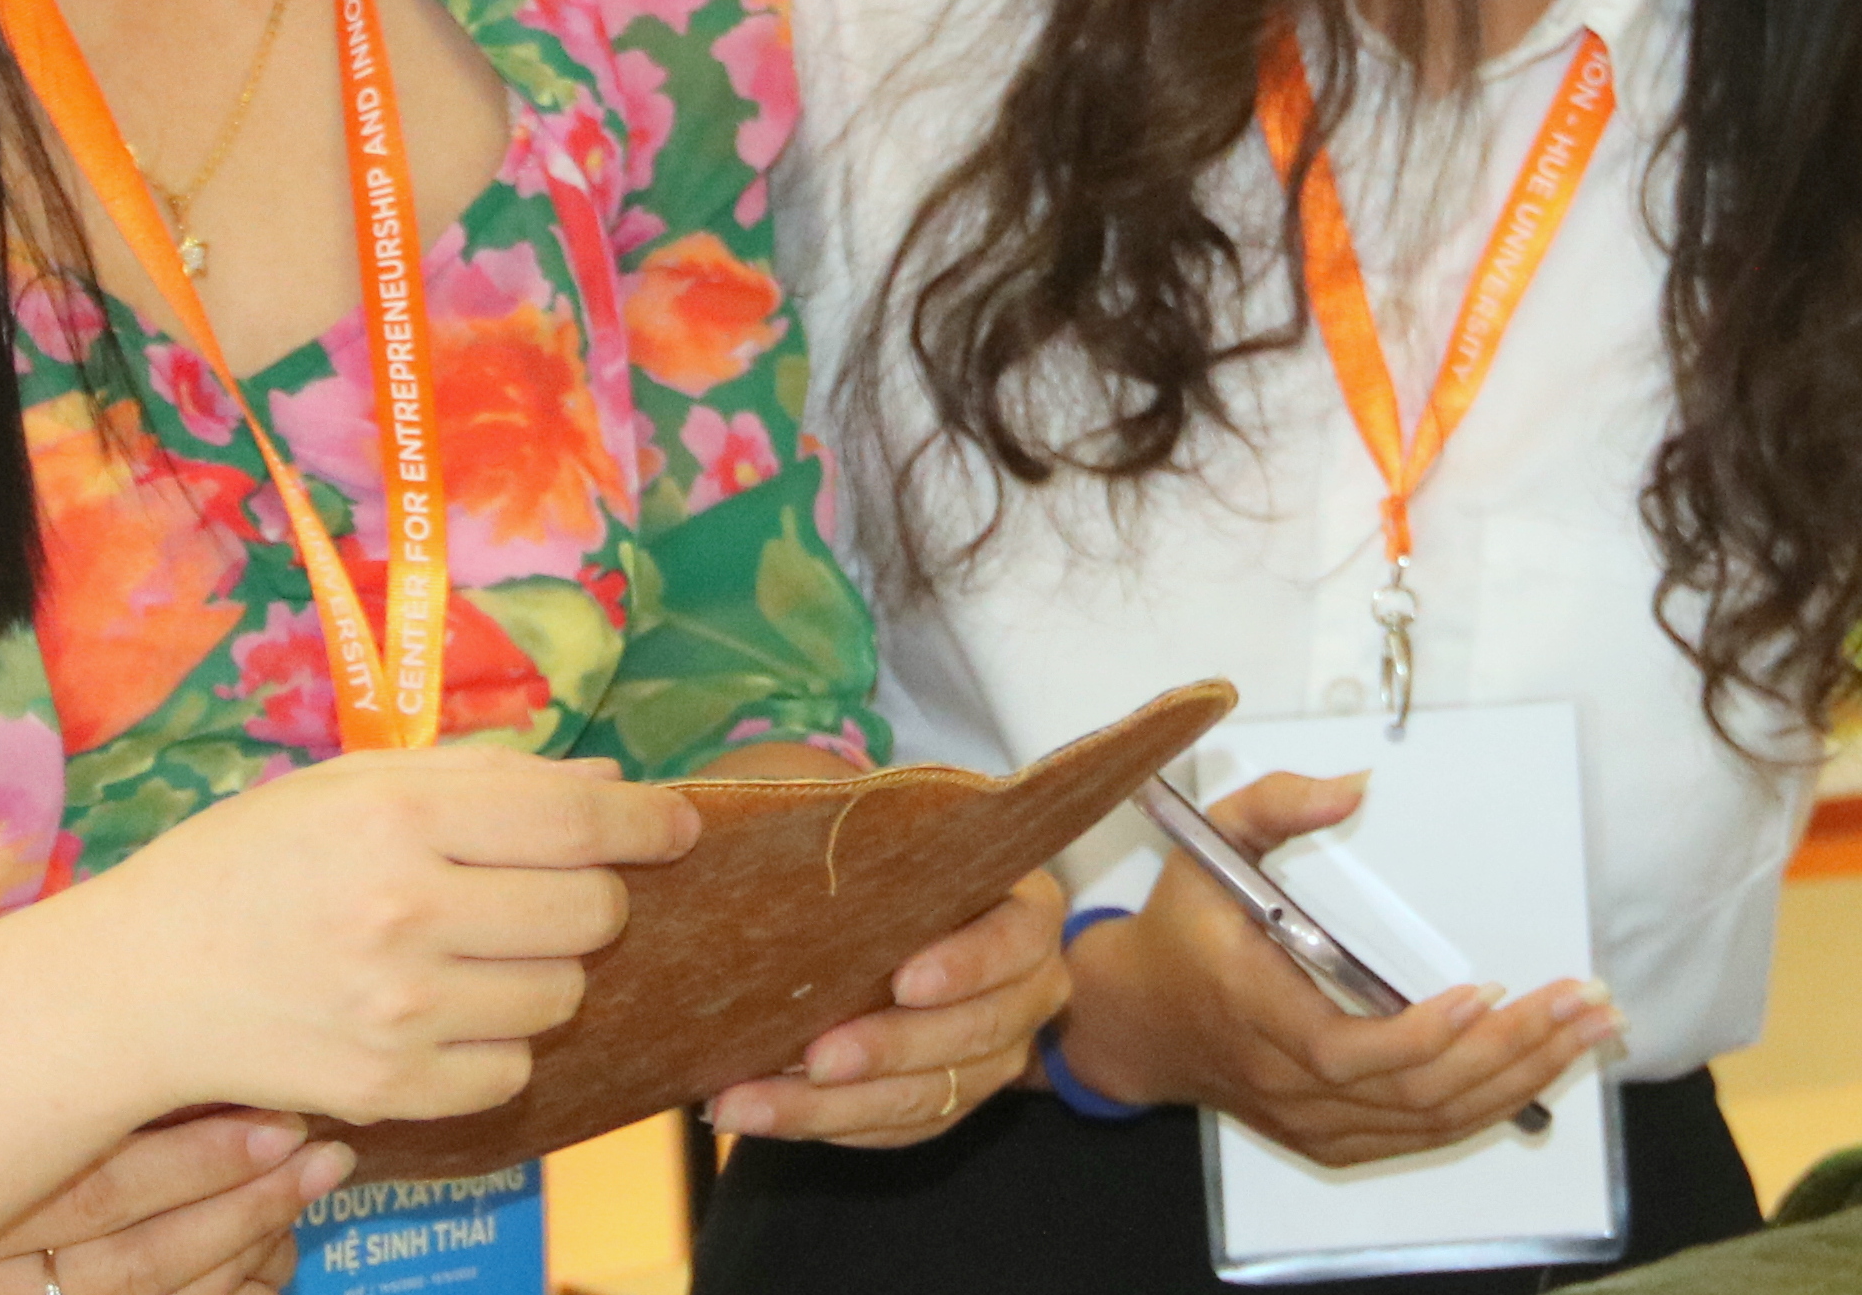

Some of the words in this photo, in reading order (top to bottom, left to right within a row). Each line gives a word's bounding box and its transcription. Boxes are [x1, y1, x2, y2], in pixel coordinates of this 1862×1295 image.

[356, 87, 388, 156] AND
[1526, 131, 1576, 200] HUE
[366, 167, 428, 482] ENTREPRENEURSHIP
[1452, 204, 1543, 383] UNIVERSITY
[402, 492, 431, 563] FOR
[301, 516, 382, 712] UNIVERSITY
[397, 572, 431, 716] CENTER
[331, 1184, 388, 1223] DUY
[325, 1228, 361, 1276] HỆ
[366, 1227, 429, 1266] SINH
